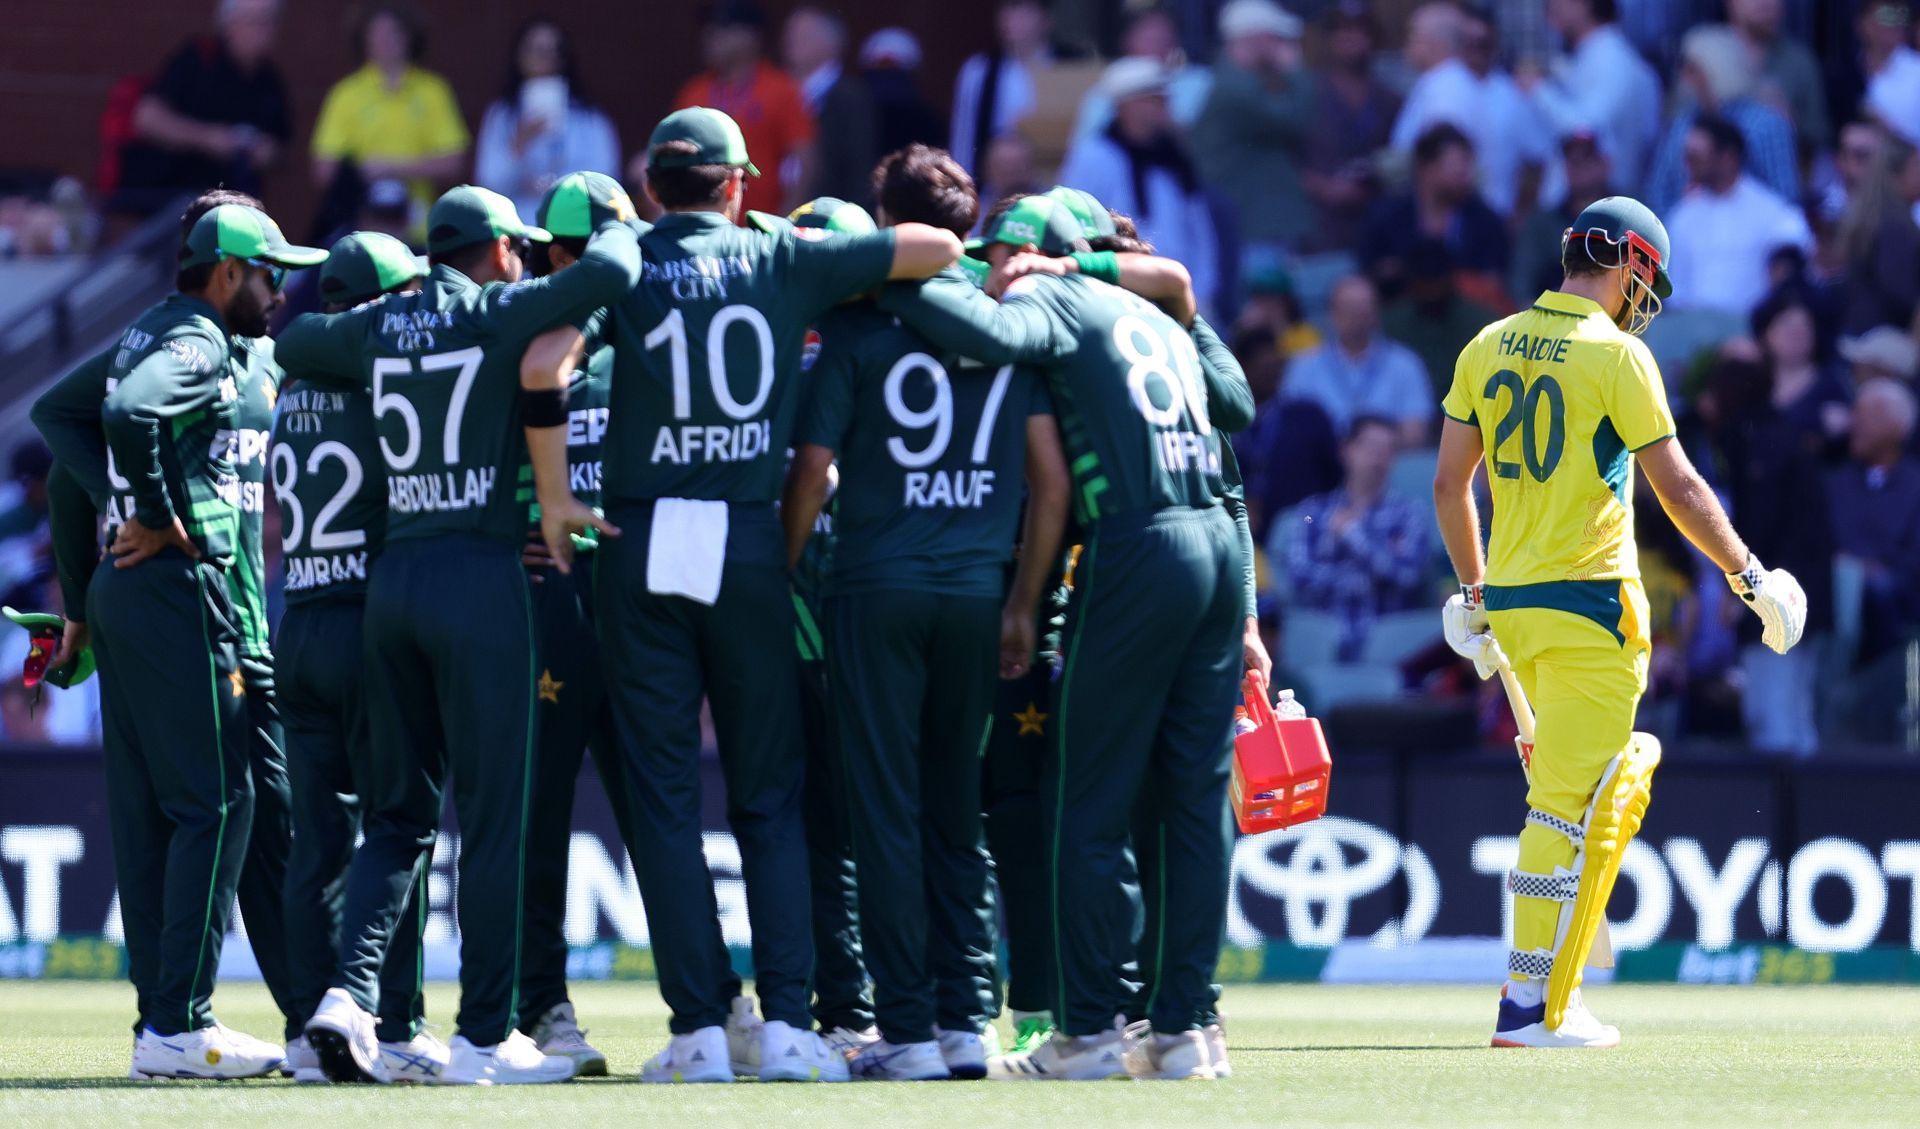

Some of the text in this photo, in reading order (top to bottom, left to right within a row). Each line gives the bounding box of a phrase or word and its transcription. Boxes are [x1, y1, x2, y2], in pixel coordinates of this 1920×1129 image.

[373, 346, 484, 472] 57
[645, 304, 775, 421] 10
[884, 352, 1014, 469] 97
[651, 420, 770, 465] AFRIDI
[1483, 369, 1566, 483] 20
[271, 440, 367, 552] 82
[387, 466, 497, 514] ABDULLAH
[904, 470, 996, 508] RAUF
